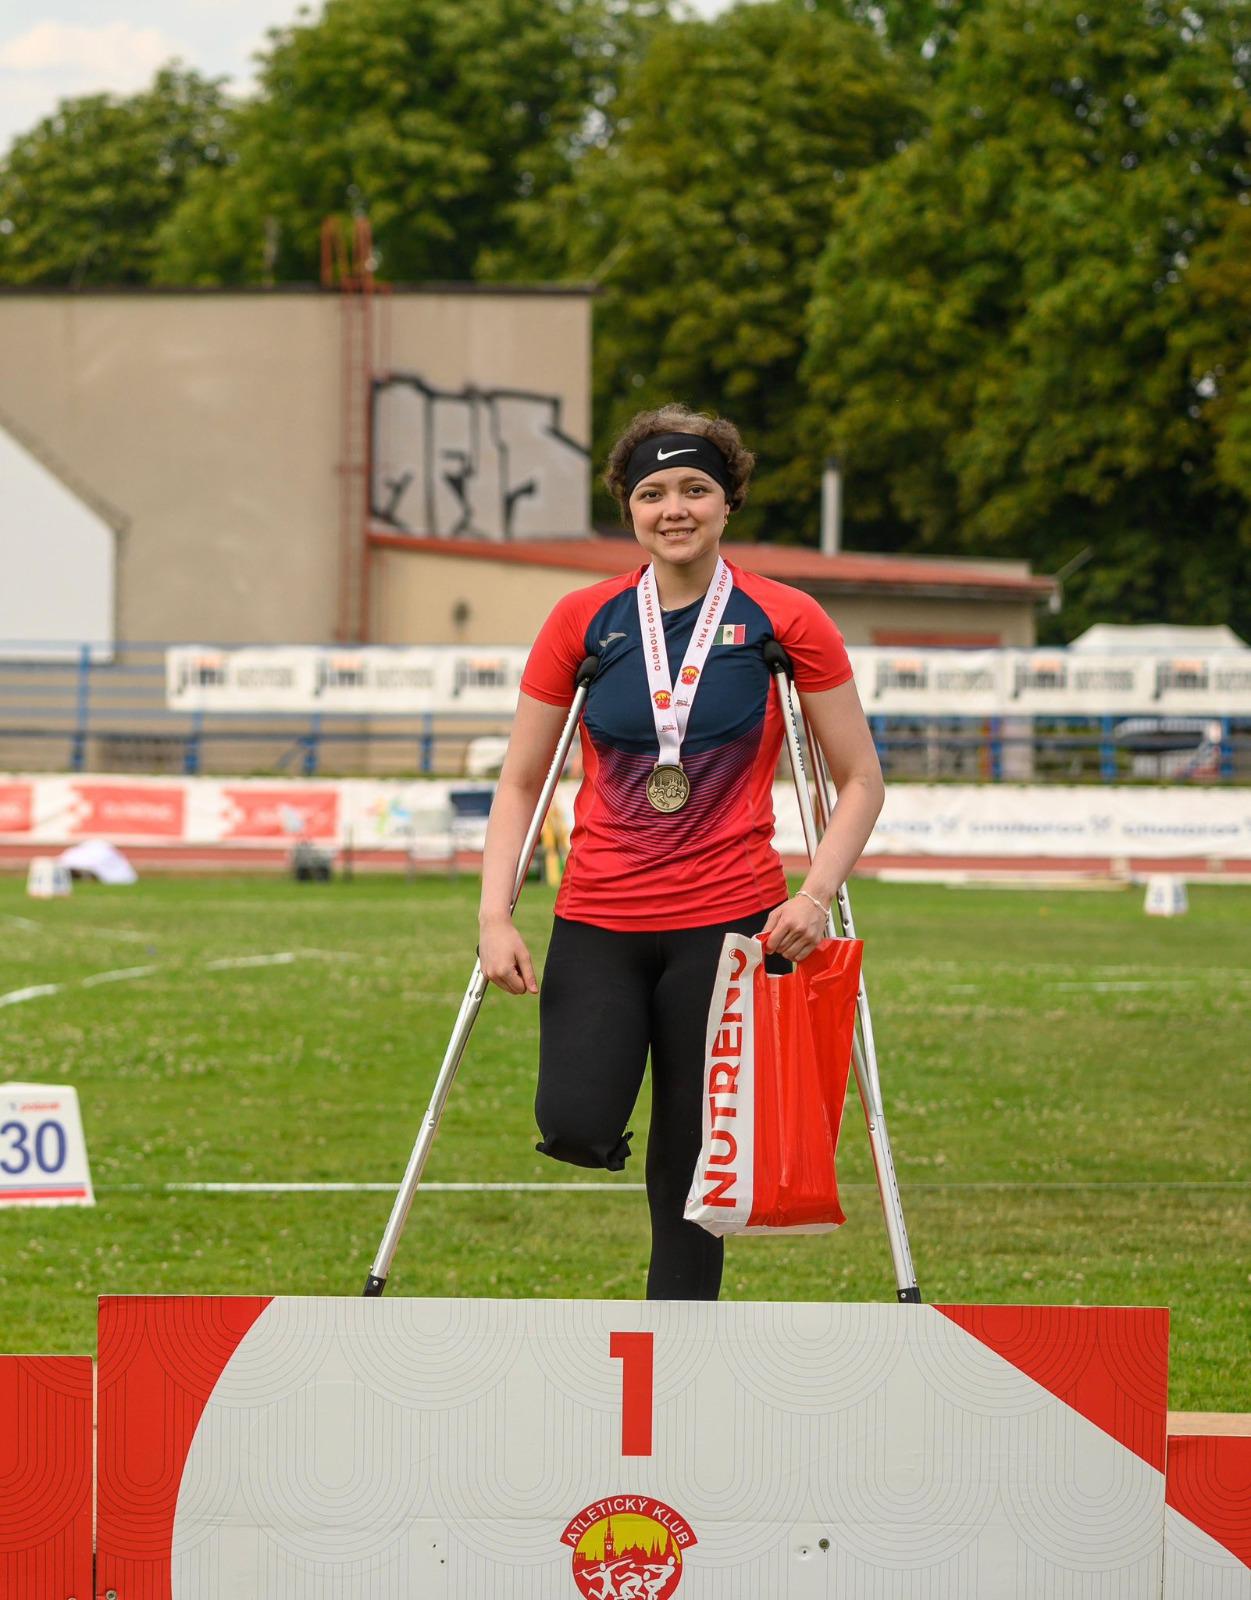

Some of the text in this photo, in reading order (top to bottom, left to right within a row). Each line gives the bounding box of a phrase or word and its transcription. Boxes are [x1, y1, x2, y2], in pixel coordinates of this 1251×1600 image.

[644, 593, 654, 624] GRAND
[705, 595, 720, 625] GRAND
[649, 626, 661, 672] OLOMOUC
[695, 628, 709, 649] PRIX
[0, 1120, 67, 1175] 30
[609, 1331, 654, 1457] 1
[566, 1497, 690, 1545] ATLETICKÝ KLUB
